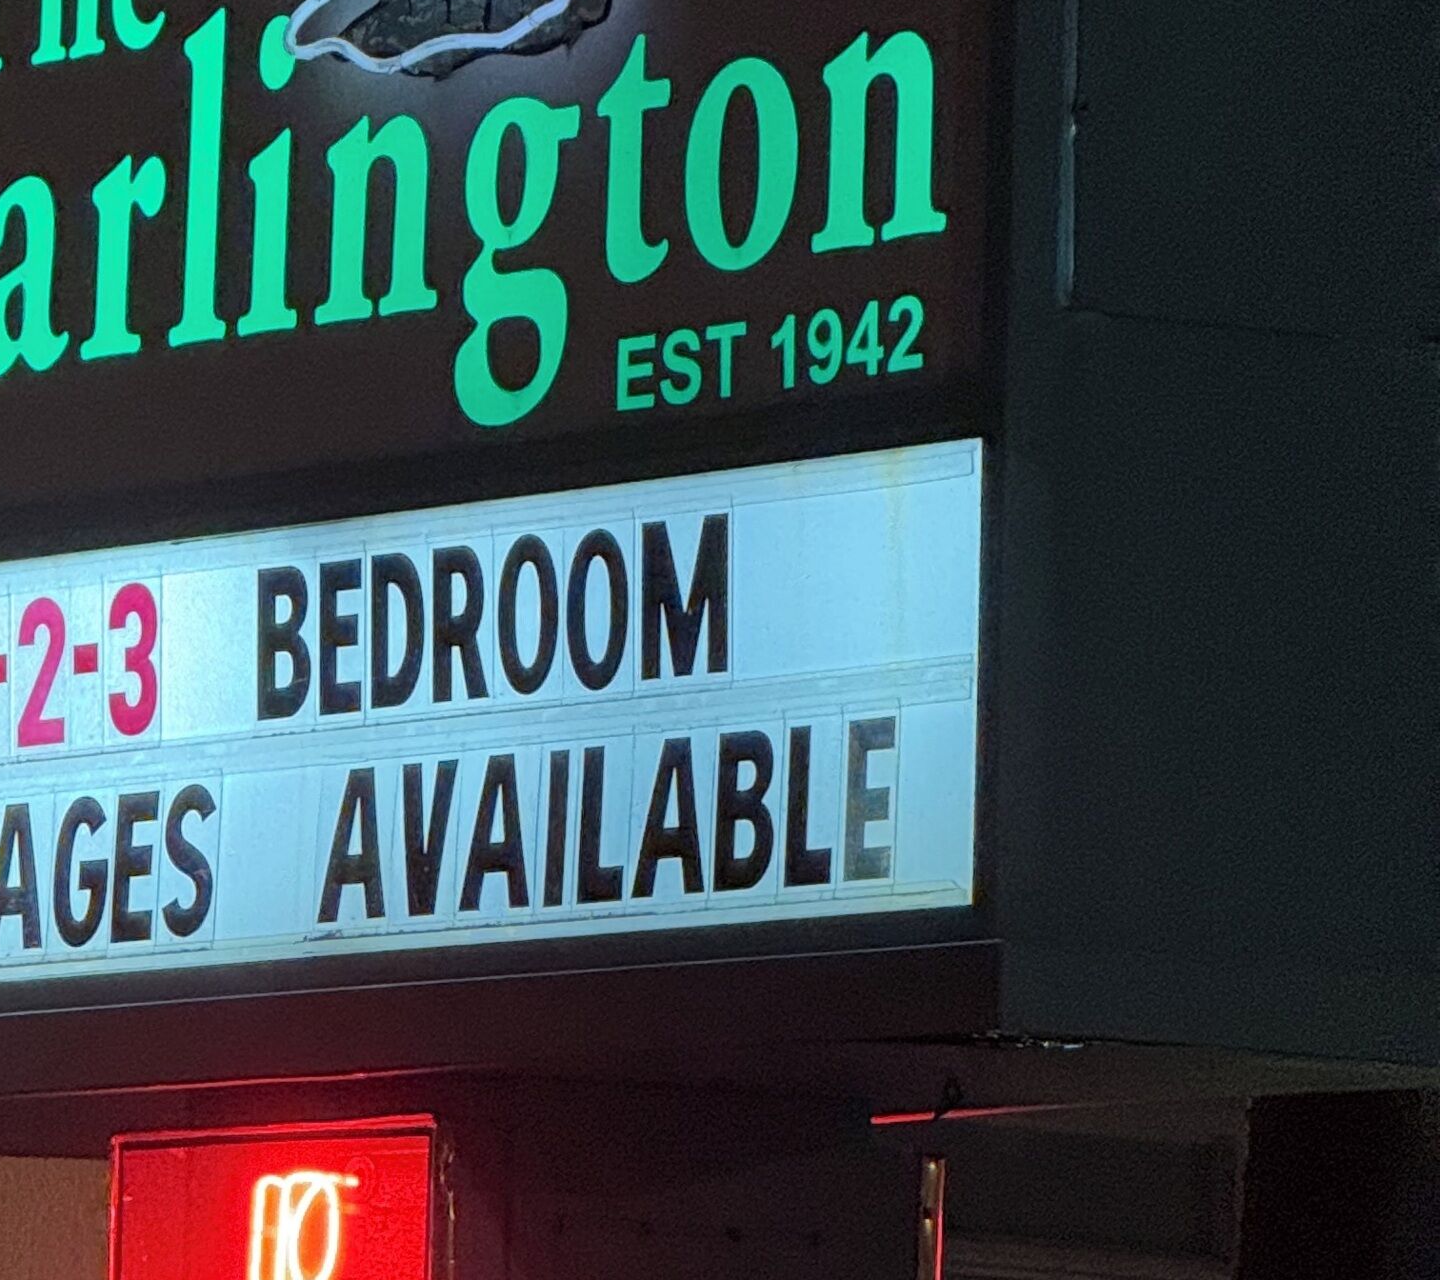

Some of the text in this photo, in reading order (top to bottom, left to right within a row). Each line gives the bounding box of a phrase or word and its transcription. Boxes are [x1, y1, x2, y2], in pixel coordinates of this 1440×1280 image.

[615, 294, 925, 412] EST 1942
[257, 512, 730, 721] BEDROOM
[316, 716, 897, 925] AVAILABLE
